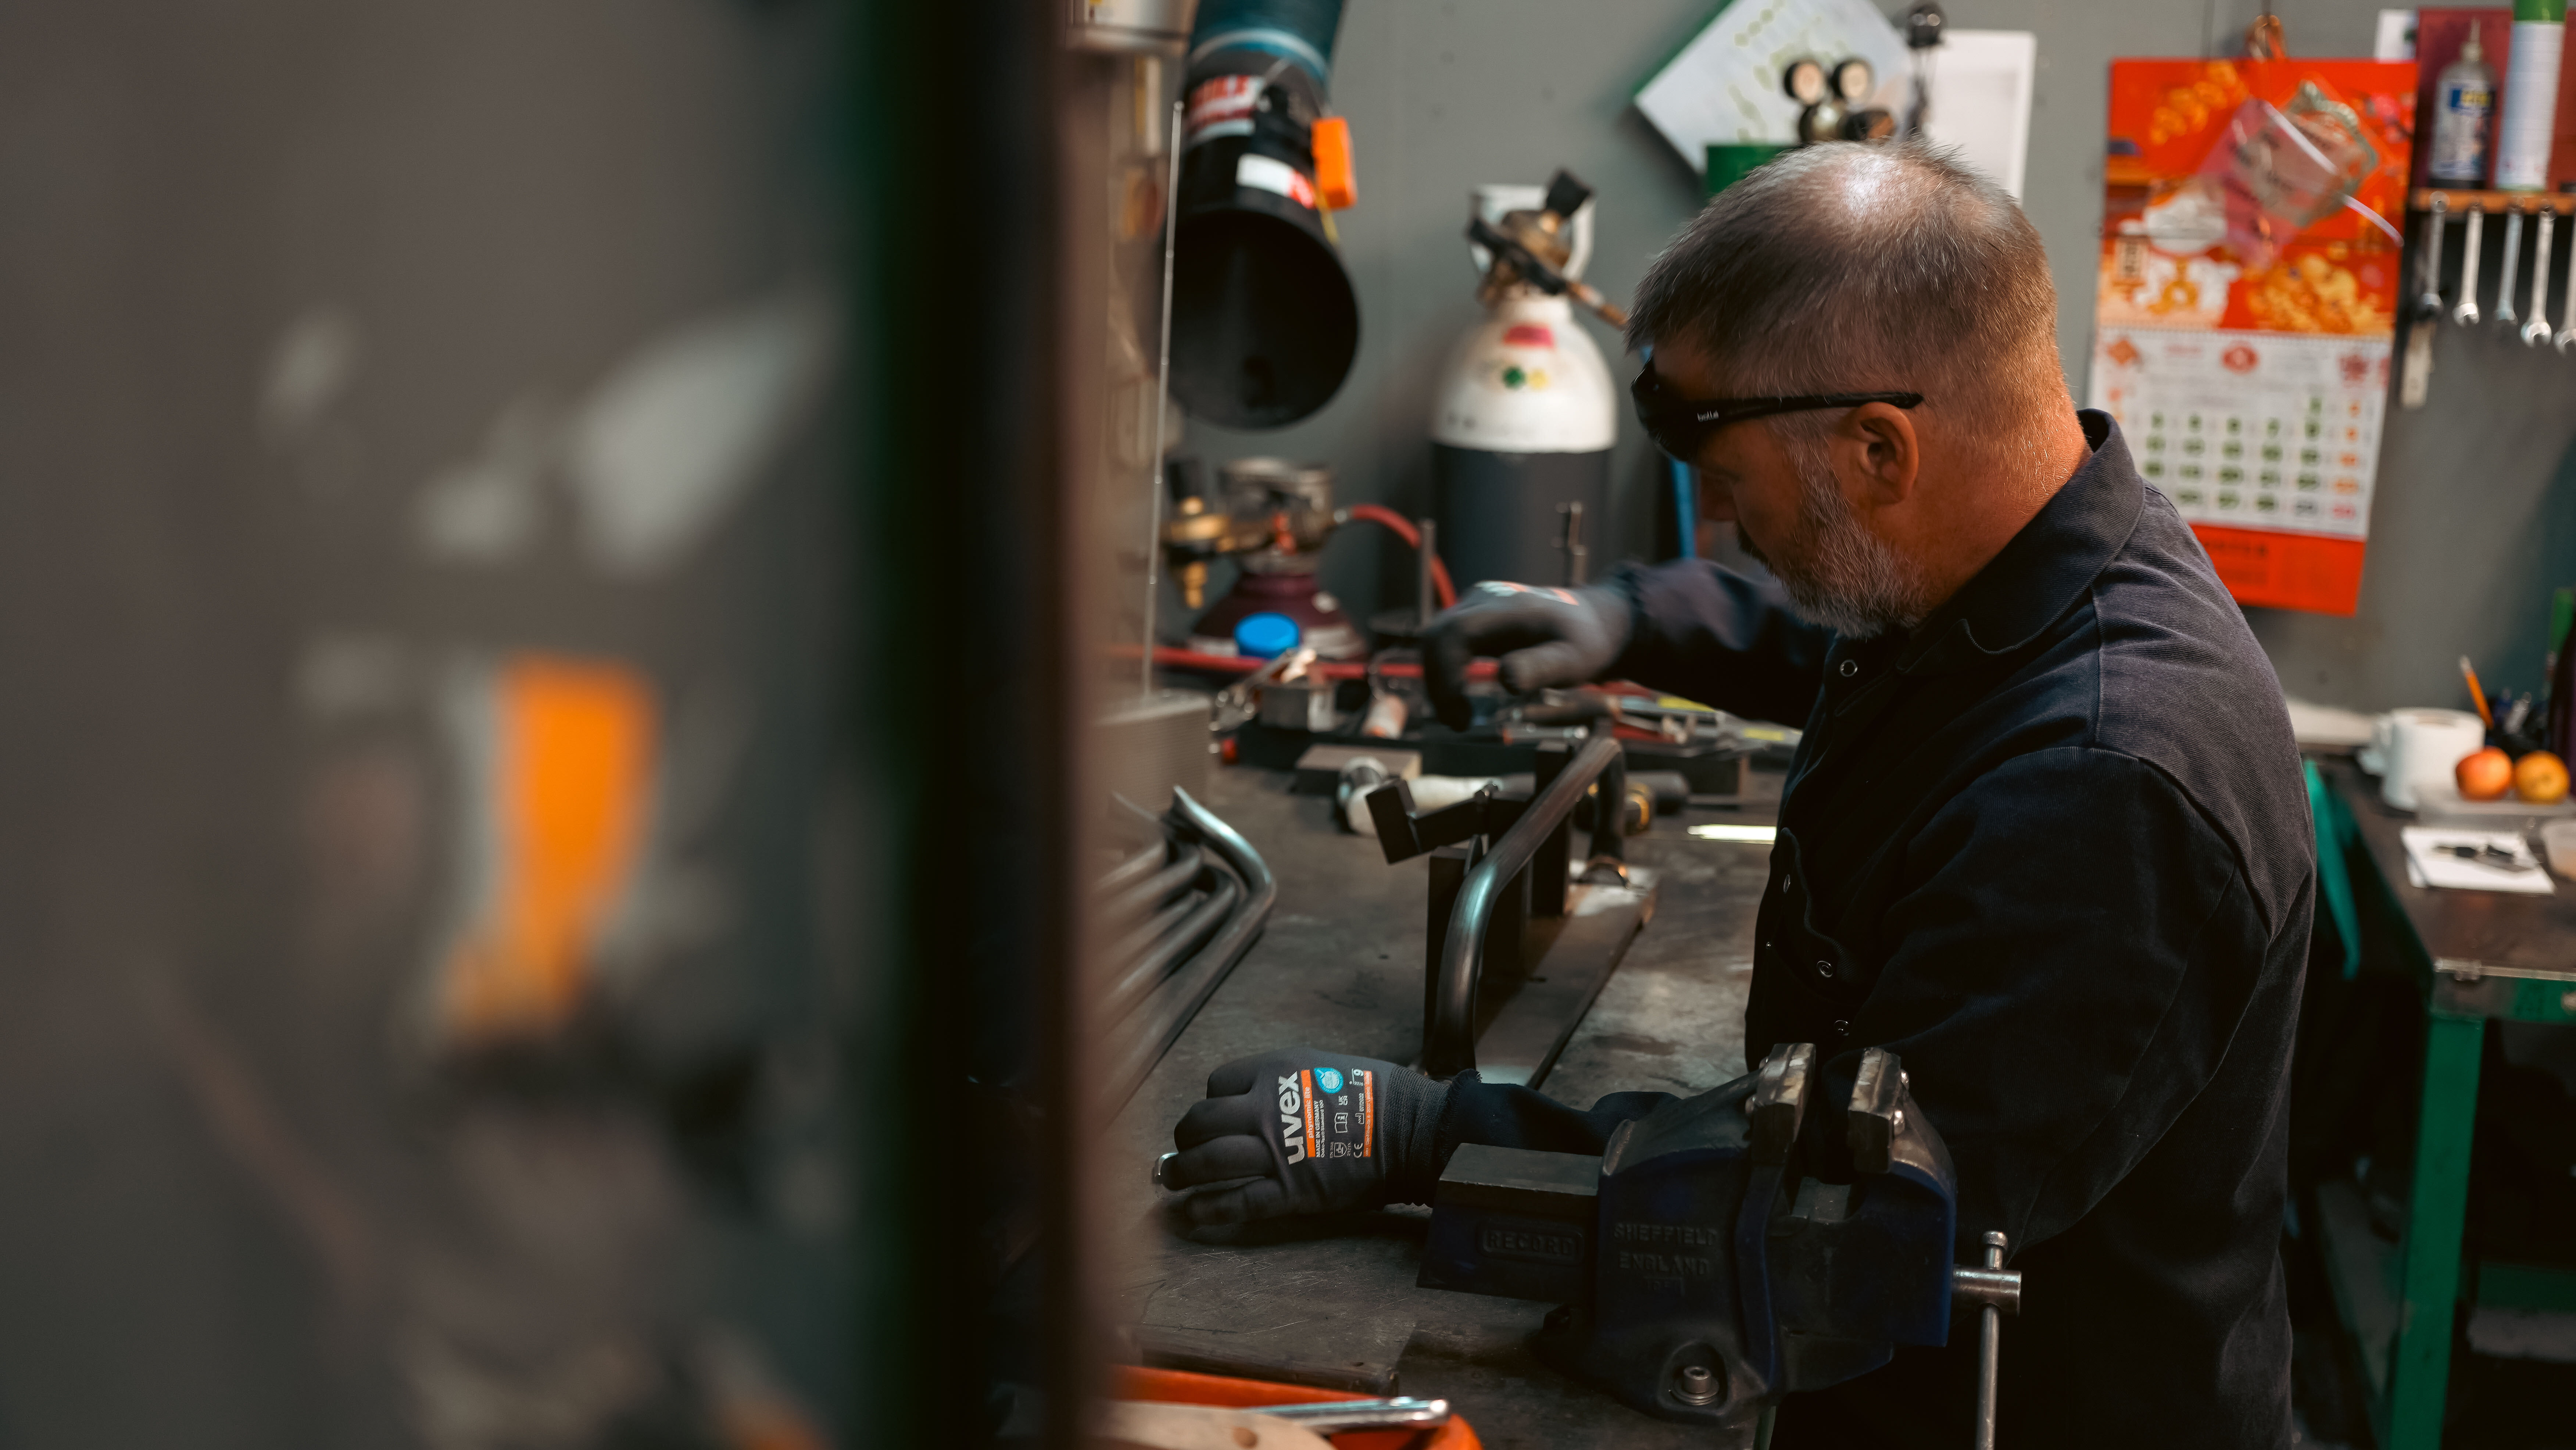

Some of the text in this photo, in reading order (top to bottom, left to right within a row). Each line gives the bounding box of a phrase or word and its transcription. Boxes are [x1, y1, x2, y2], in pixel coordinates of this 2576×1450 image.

[1278, 1071, 1305, 1165] uvex
[1305, 1100, 1314, 1139] phynomic
[1487, 1231, 1574, 1256] RECORD
[1613, 1222, 1717, 1247] SHEFFIELD
[1618, 1251, 1710, 1275] ENGLAND
